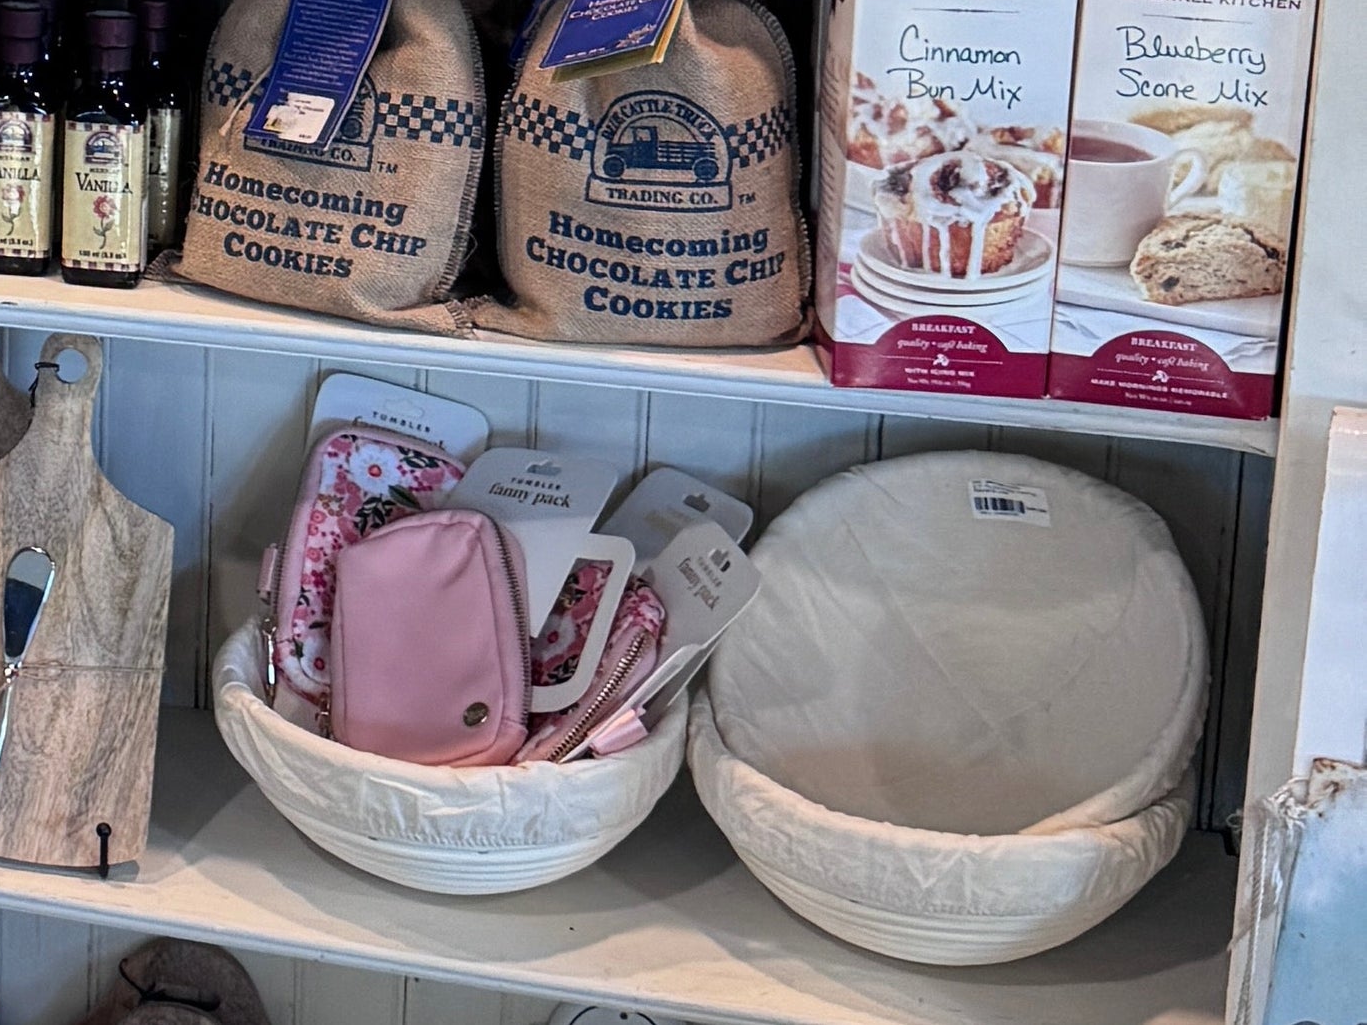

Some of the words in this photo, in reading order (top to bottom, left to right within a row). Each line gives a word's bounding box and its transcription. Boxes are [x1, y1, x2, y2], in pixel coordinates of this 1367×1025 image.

[898, 23, 1021, 66] Cinnamon
[1115, 25, 1268, 74] Blueberry
[886, 67, 956, 103] Bun
[959, 80, 1023, 109] Mix
[1115, 67, 1196, 103] Scone
[1210, 79, 1269, 108] Mix
[619, 98, 675, 119] CATTLE
[202, 159, 409, 227] Homecoming
[605, 187, 684, 205] TRADING
[688, 190, 719, 206] CO.
[193, 193, 344, 245] HOCOLATE
[350, 222, 428, 258] CHIP
[548, 211, 769, 258] Homecoming
[223, 230, 354, 279] COOKIES
[525, 238, 721, 291] CHOCOLATE
[724, 251, 786, 286] CHIP
[583, 284, 734, 322] COOKIES
[910, 322, 976, 335] BREAKFAST
[1130, 336, 1199, 352] BREAKFAST
[370, 410, 432, 434] TUMBLER
[488, 483, 530, 505] fanny
[531, 491, 572, 510] pack
